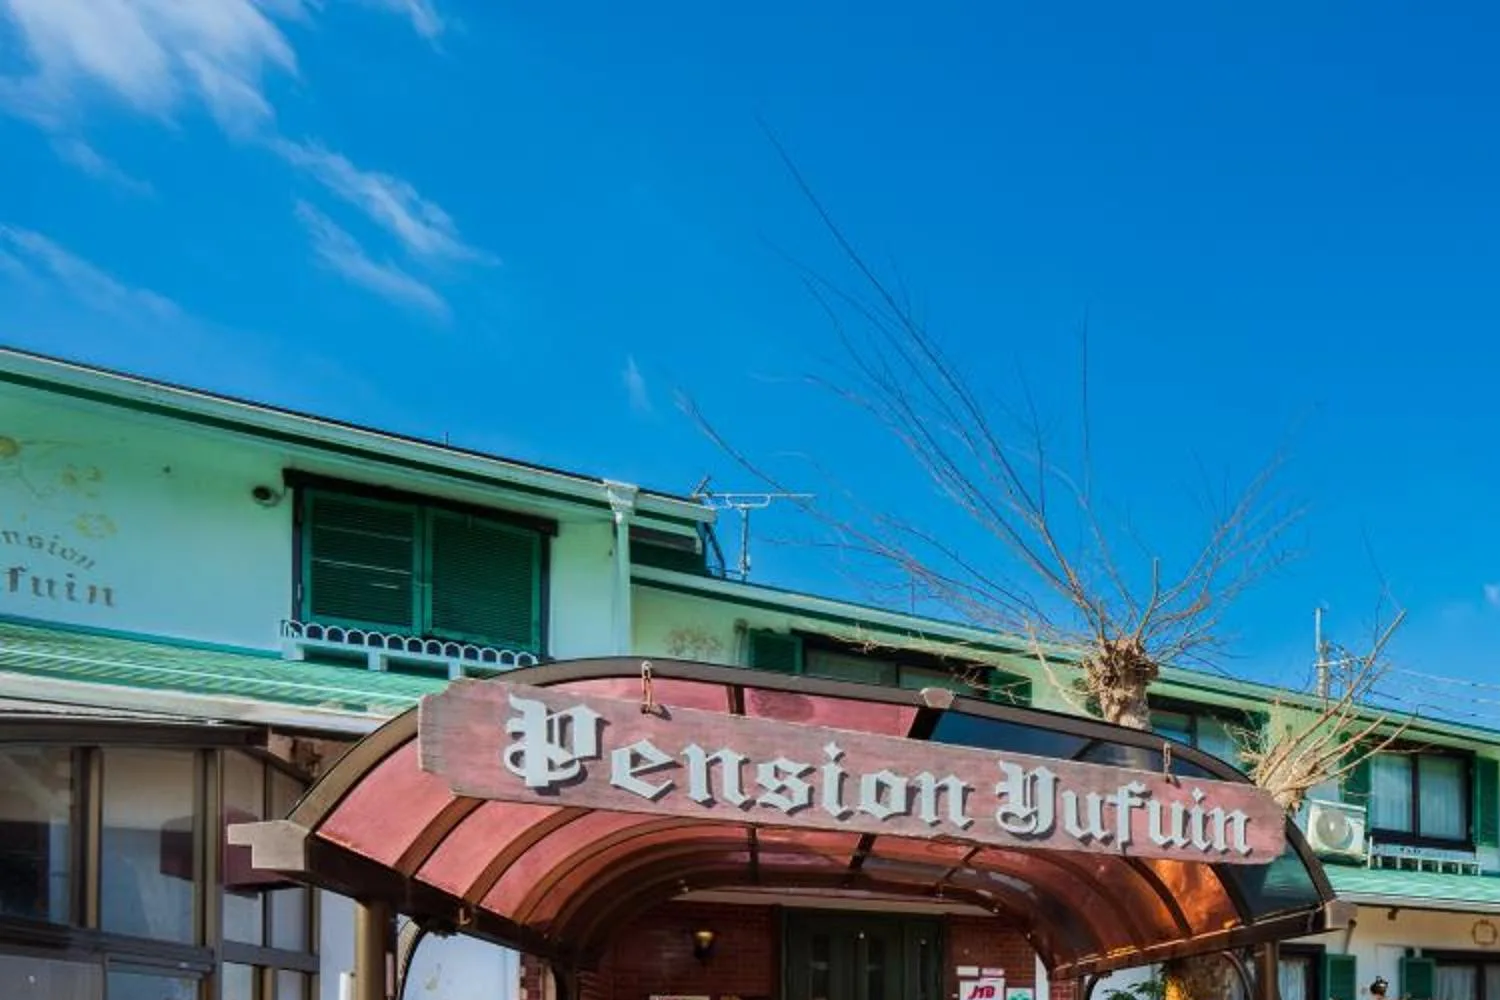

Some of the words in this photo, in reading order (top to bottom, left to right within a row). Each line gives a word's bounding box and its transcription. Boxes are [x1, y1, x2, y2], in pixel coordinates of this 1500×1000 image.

[504, 693, 974, 829] Pension
[996, 759, 1252, 854] Yufuin
[968, 985, 996, 1000] JTB
